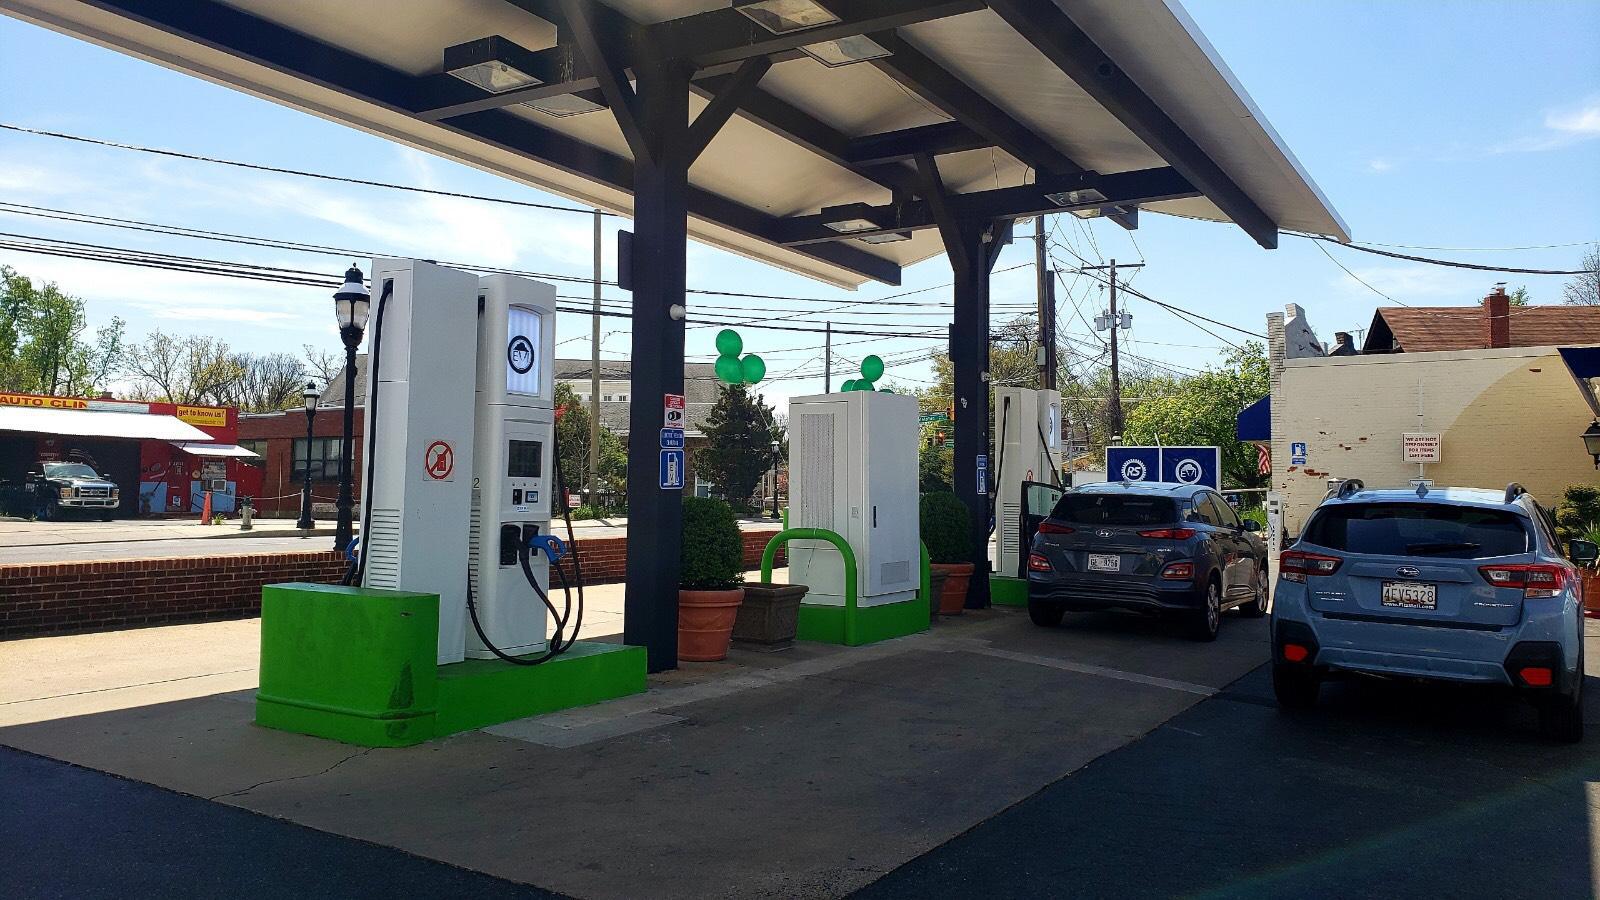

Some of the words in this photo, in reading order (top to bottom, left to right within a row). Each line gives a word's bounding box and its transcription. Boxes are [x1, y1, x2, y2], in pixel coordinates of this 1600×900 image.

[0, 396, 44, 406] AUTO
[178, 409, 189, 417] get
[197, 409, 214, 418] know
[214, 410, 225, 418] us!
[1126, 466, 1141, 477] RS
[472, 477, 480, 489] 2
